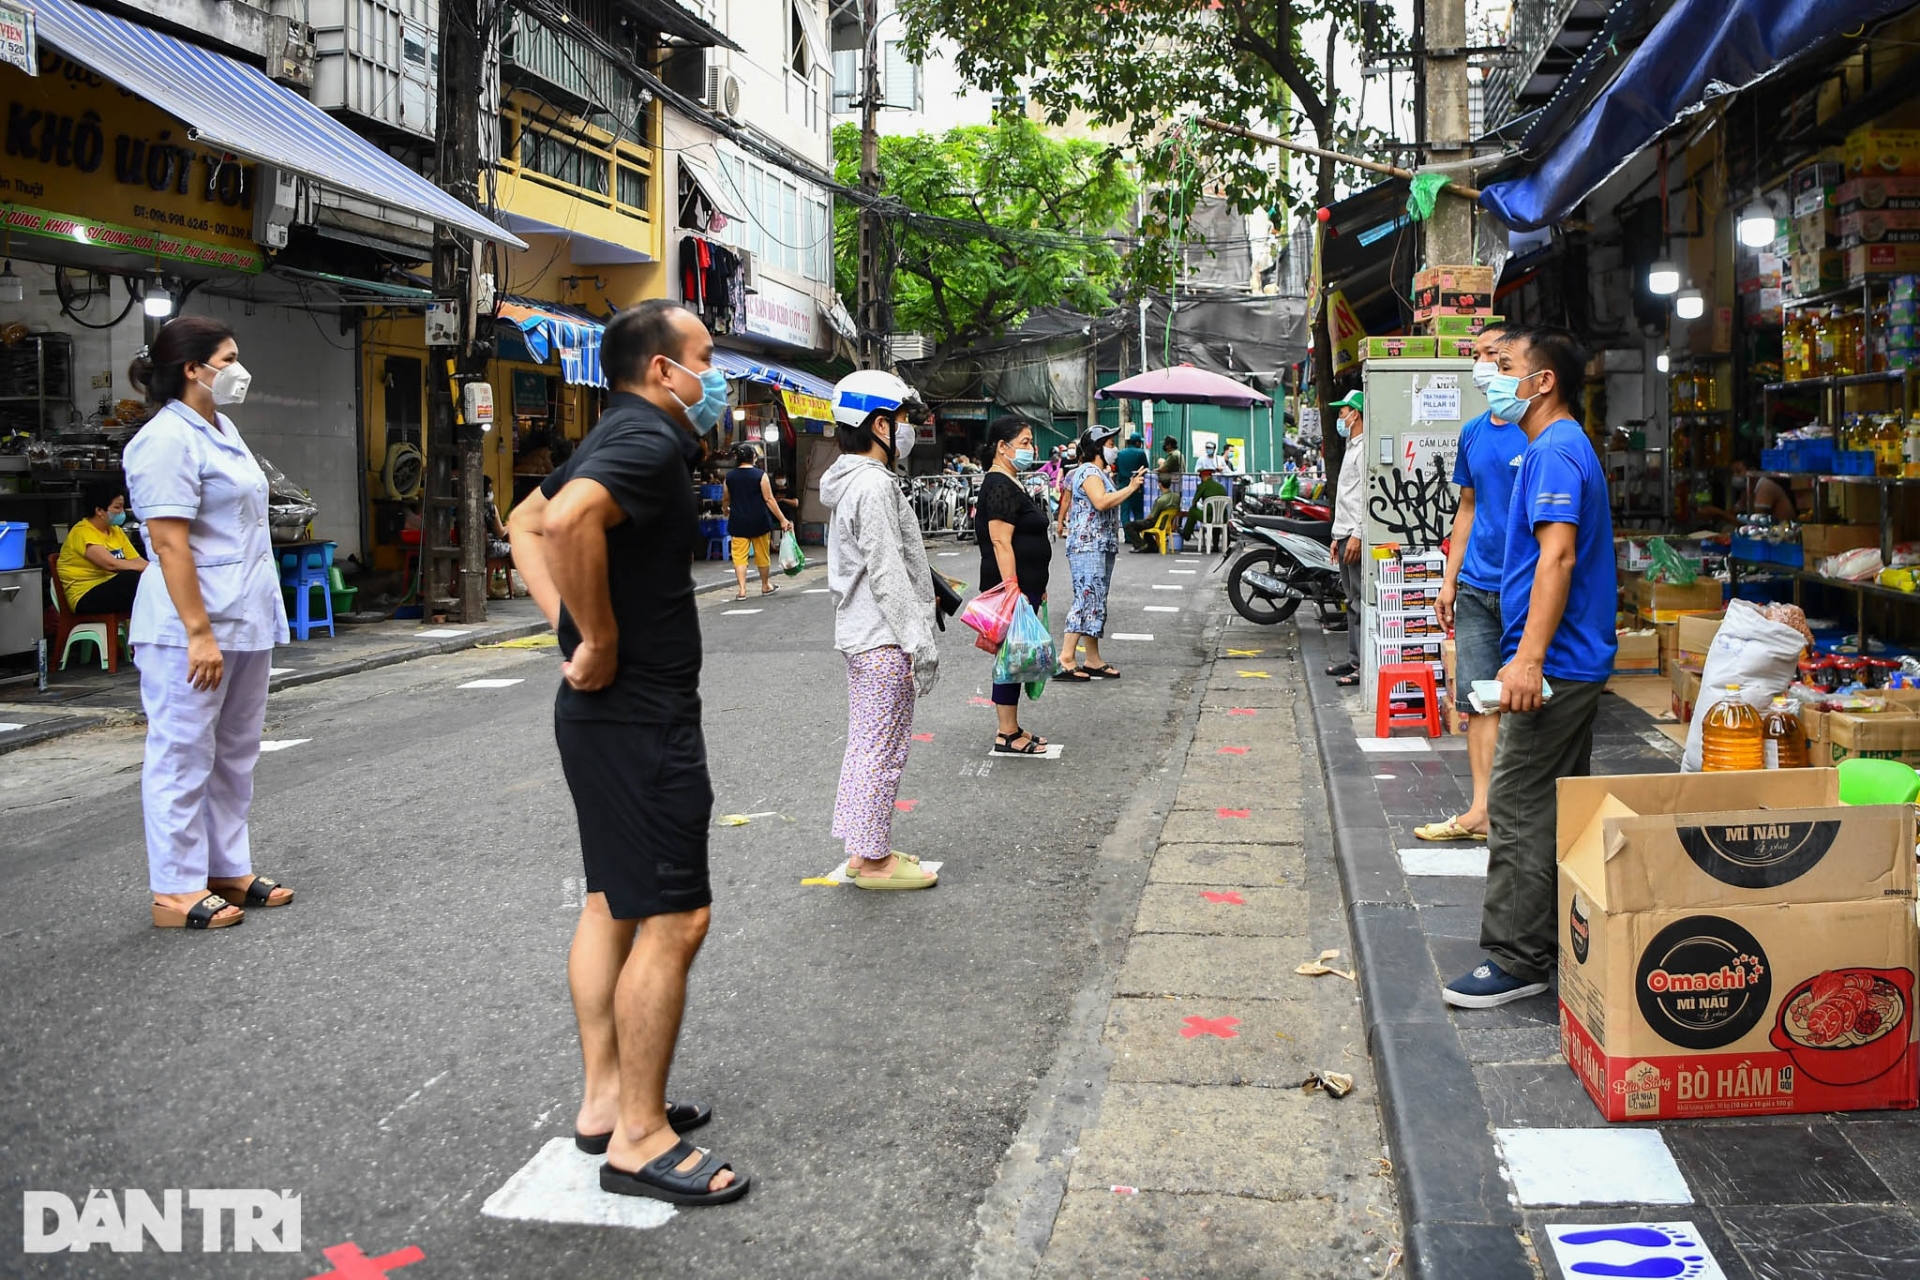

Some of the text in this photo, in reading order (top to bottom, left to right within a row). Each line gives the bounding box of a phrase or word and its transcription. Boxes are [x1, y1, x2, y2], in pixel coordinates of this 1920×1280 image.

[8, 42, 25, 56] 520
[7, 101, 104, 173] KHÔ
[15, 178, 44, 197] Thuật
[1419, 436, 1436, 448] CẤM
[1647, 966, 1746, 992] Omachi
[1677, 996, 1695, 1010] MÌ
[1677, 1060, 1772, 1100] BÒ HẦM
[1779, 1066, 1792, 1080] 10
[1780, 1080, 1792, 1091] GÓI
